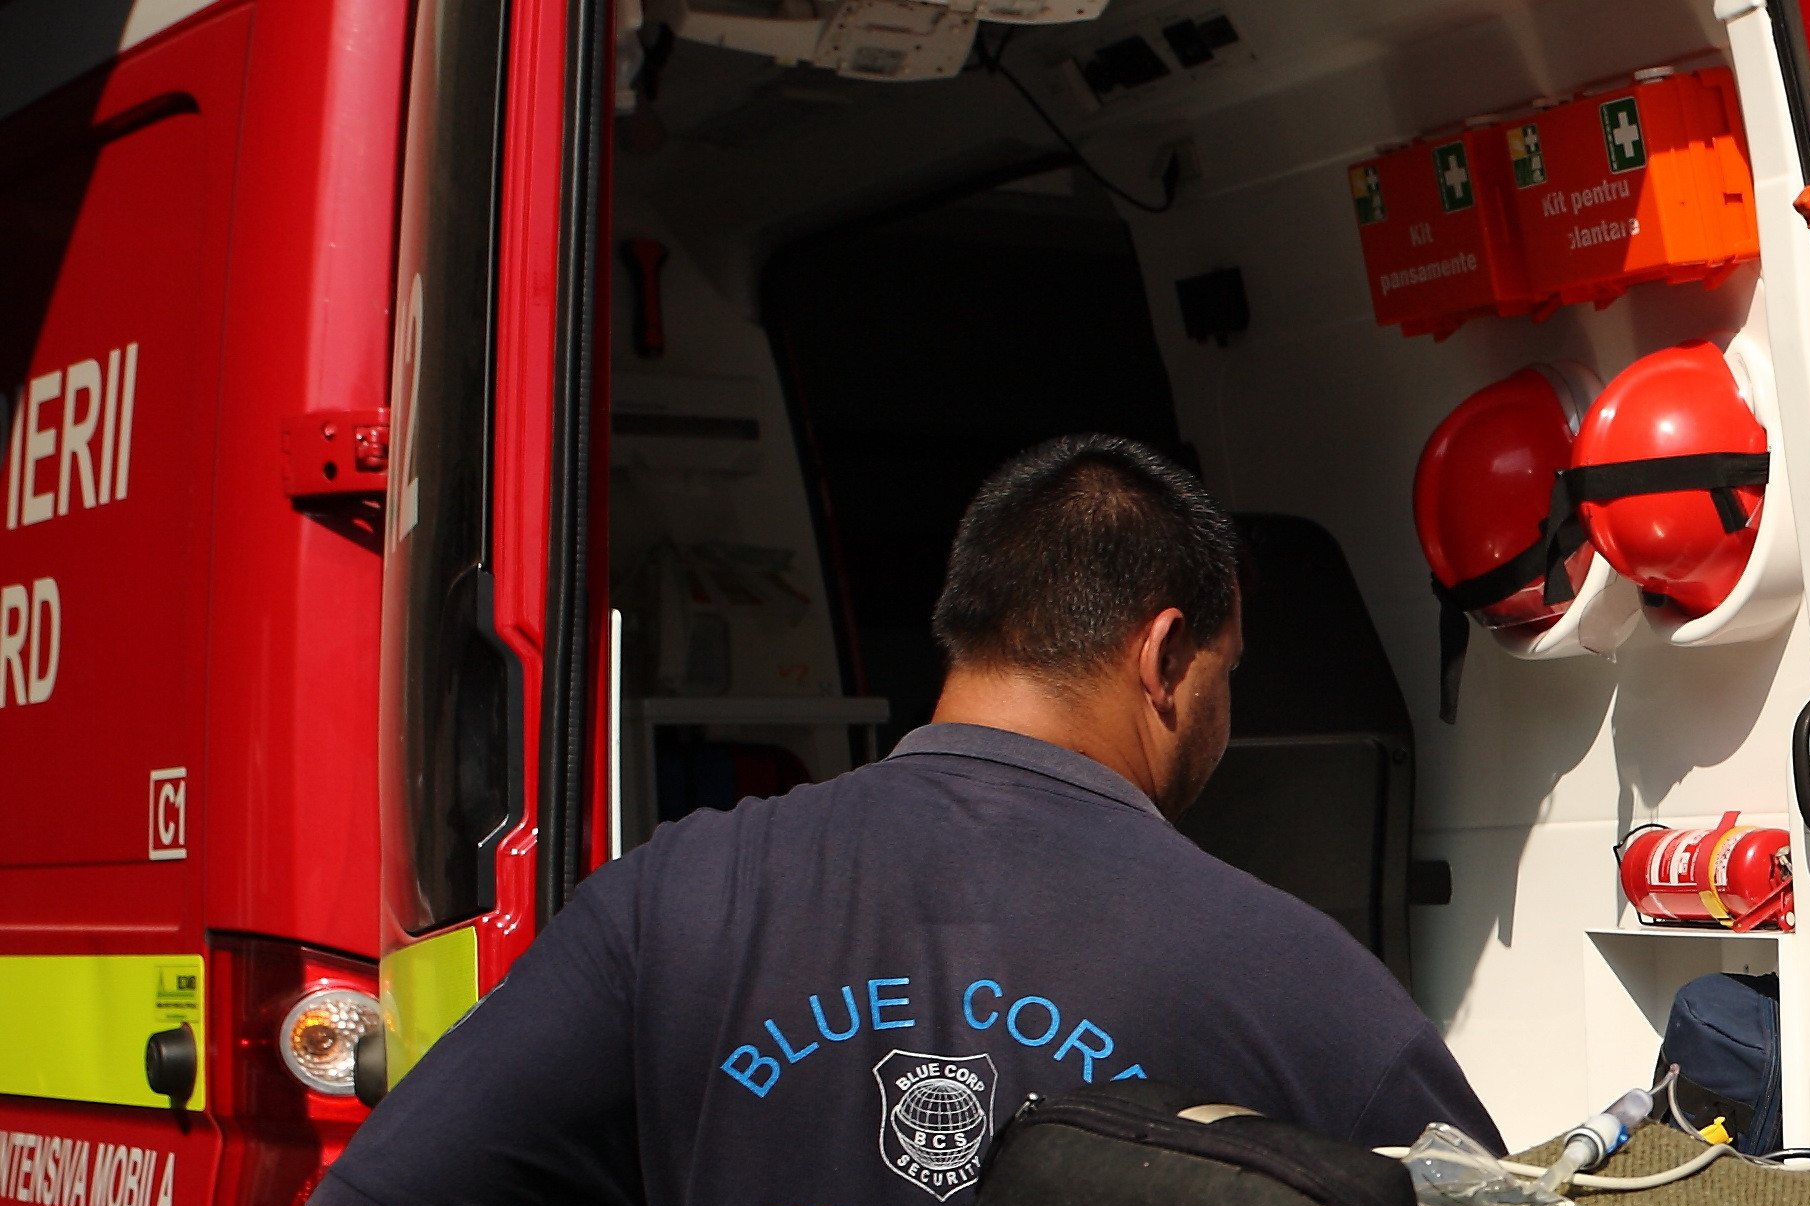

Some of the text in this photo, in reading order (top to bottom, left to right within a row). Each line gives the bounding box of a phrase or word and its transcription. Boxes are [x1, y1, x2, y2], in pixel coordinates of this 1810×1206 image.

[1541, 179, 1631, 217] Kit pentru
[1409, 222, 1434, 247] Kit
[1380, 252, 1477, 296] pansamente
[719, 976, 917, 1099] BLUE
[895, 1062, 986, 1092] BLUE CORP
[896, 1154, 982, 1187] SECURITY
